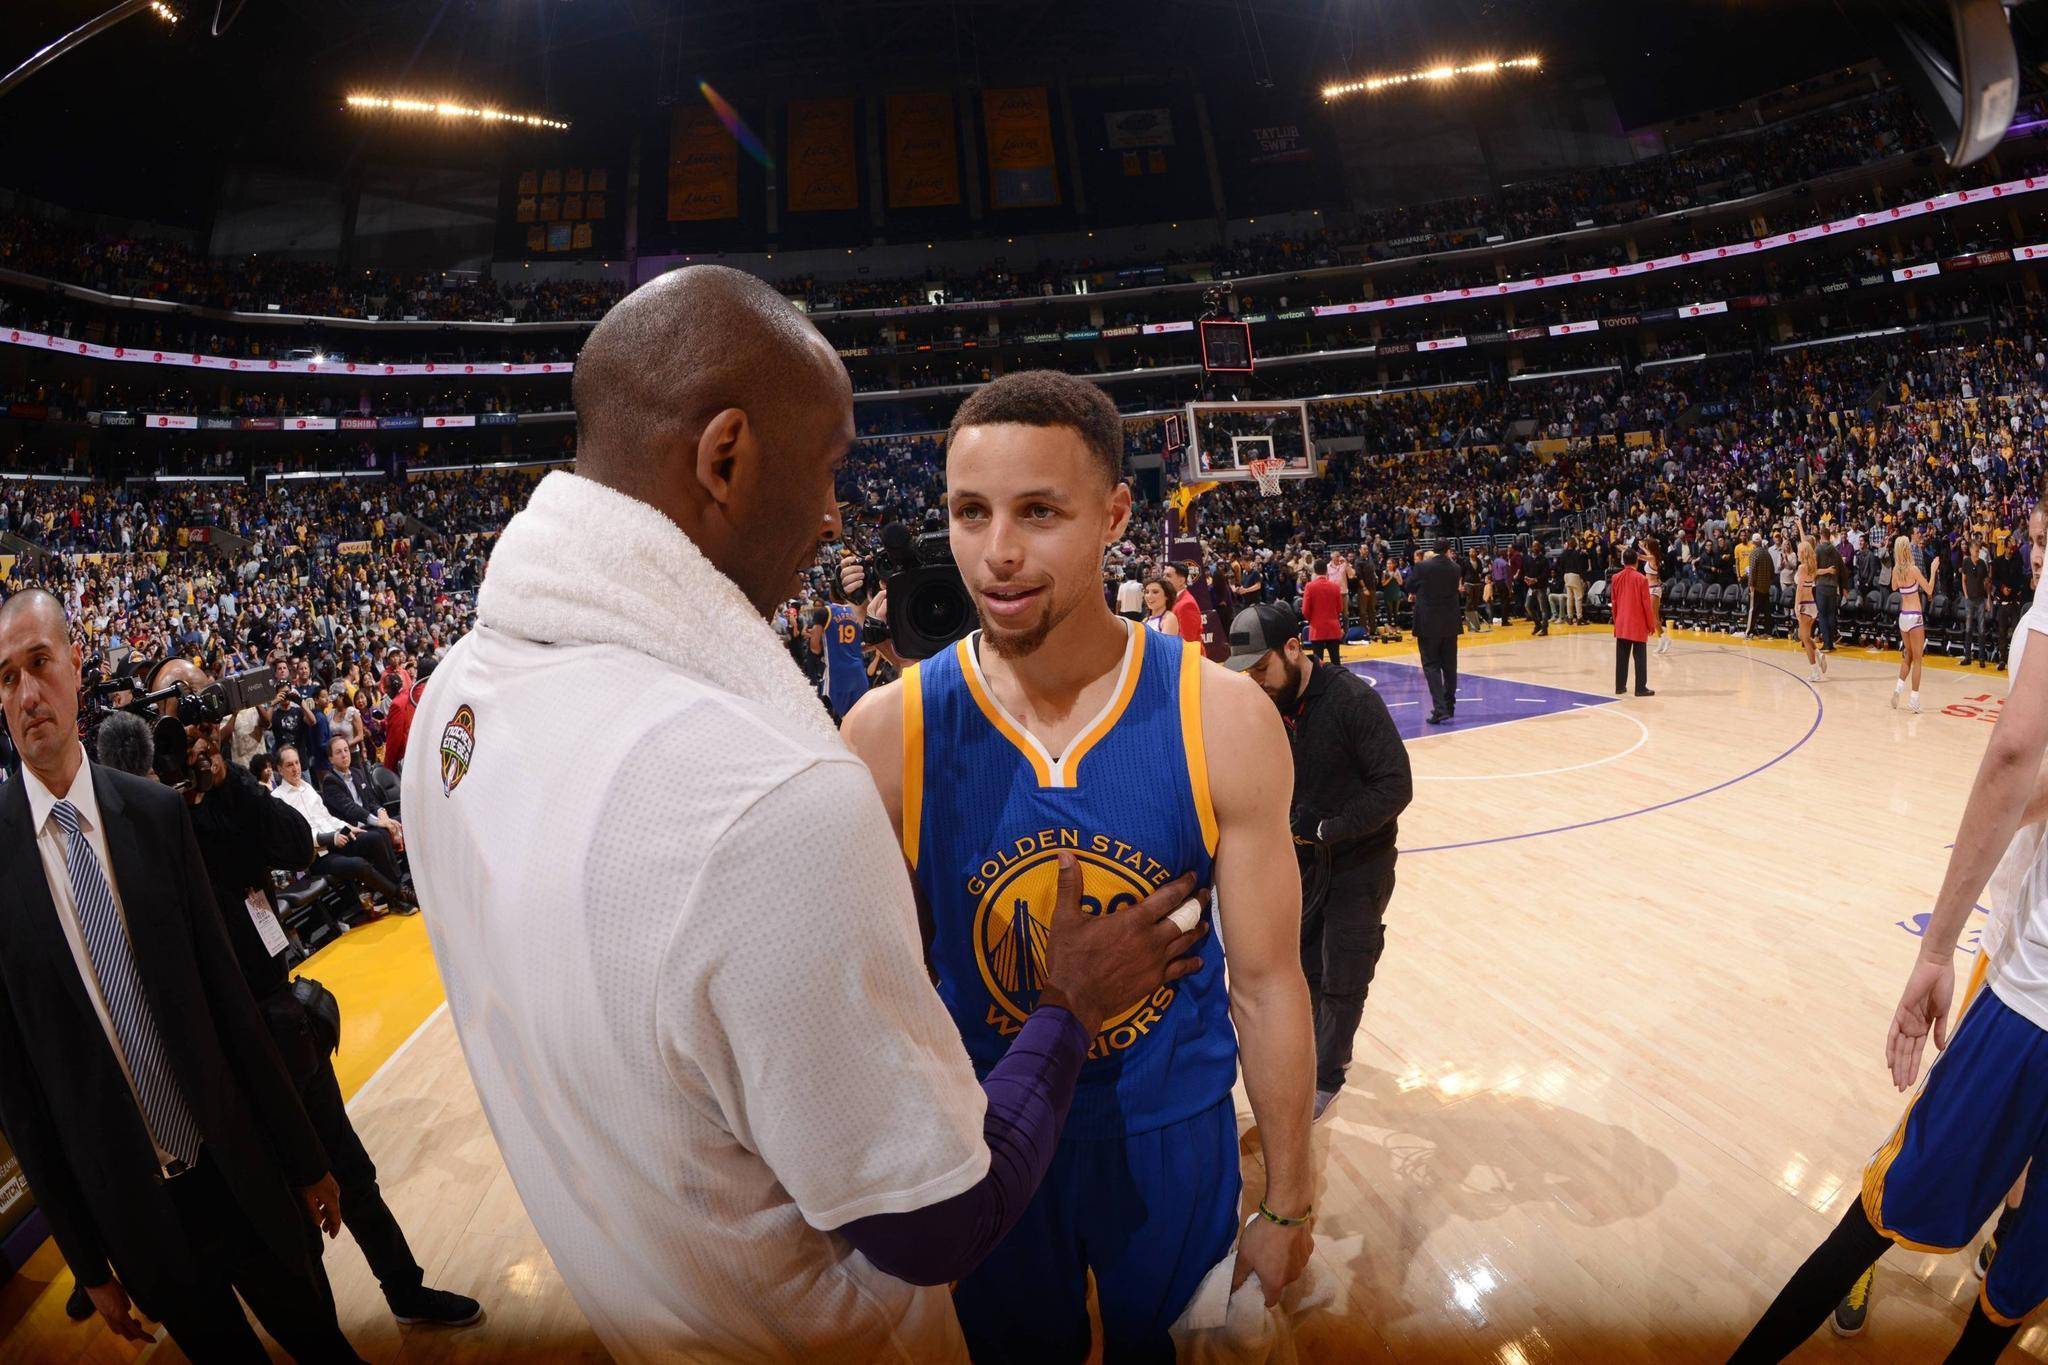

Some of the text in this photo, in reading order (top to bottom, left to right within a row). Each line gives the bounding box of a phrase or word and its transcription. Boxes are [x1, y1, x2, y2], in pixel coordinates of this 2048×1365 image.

[1254, 127, 1300, 140] TAYLOR
[1260, 138, 1297, 151] SWIFT
[1977, 251, 2012, 265] TOSHIBA
[1822, 281, 1849, 293] verizon
[1277, 310, 1306, 321] verizon
[1602, 317, 1639, 328] TOYOTA
[1102, 326, 1139, 338] TOSHIBA
[1379, 343, 1410, 355] STAPLES
[106, 415, 135, 426] verizon
[341, 418, 378, 430] TOSHIBA
[838, 624, 858, 644] 19
[967, 828, 1171, 896] GOLDEN STATE
[985, 984, 1176, 1061] WRIORS
